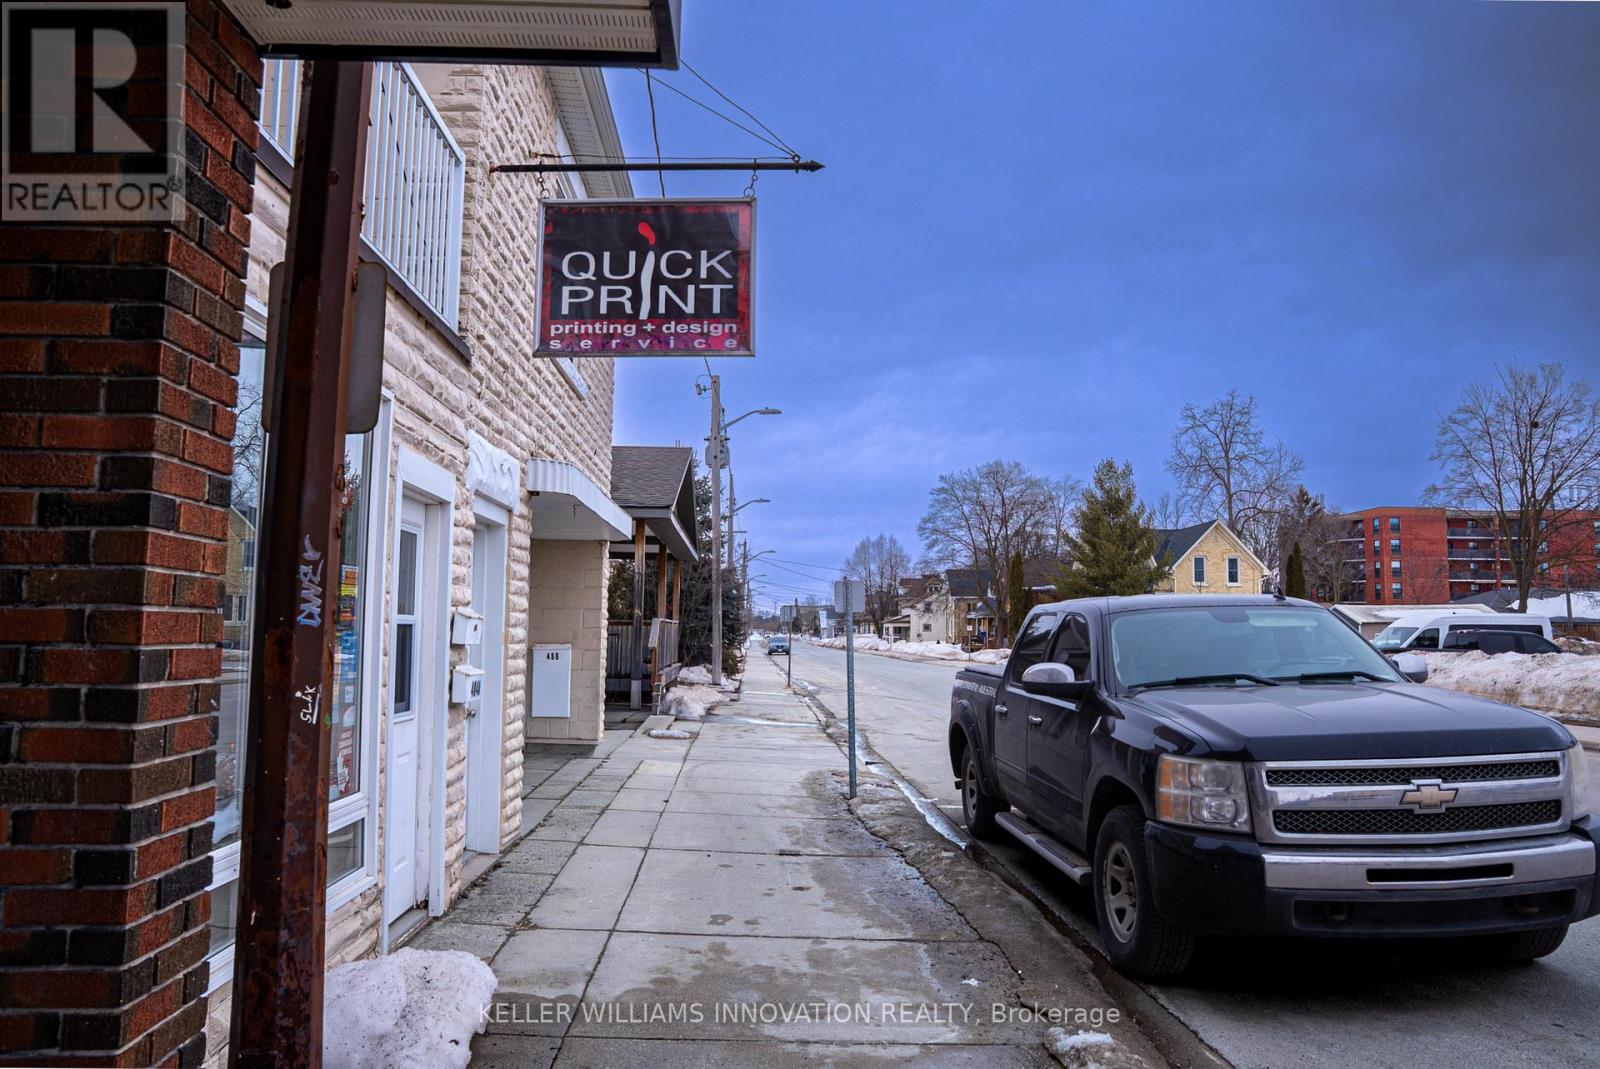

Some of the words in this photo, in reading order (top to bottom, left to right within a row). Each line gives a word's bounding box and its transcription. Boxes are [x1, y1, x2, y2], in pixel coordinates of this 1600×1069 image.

[561, 250, 733, 280] QUICK
[560, 284, 734, 320] PRINT
[550, 321, 637, 336] printing
[662, 321, 737, 335] design
